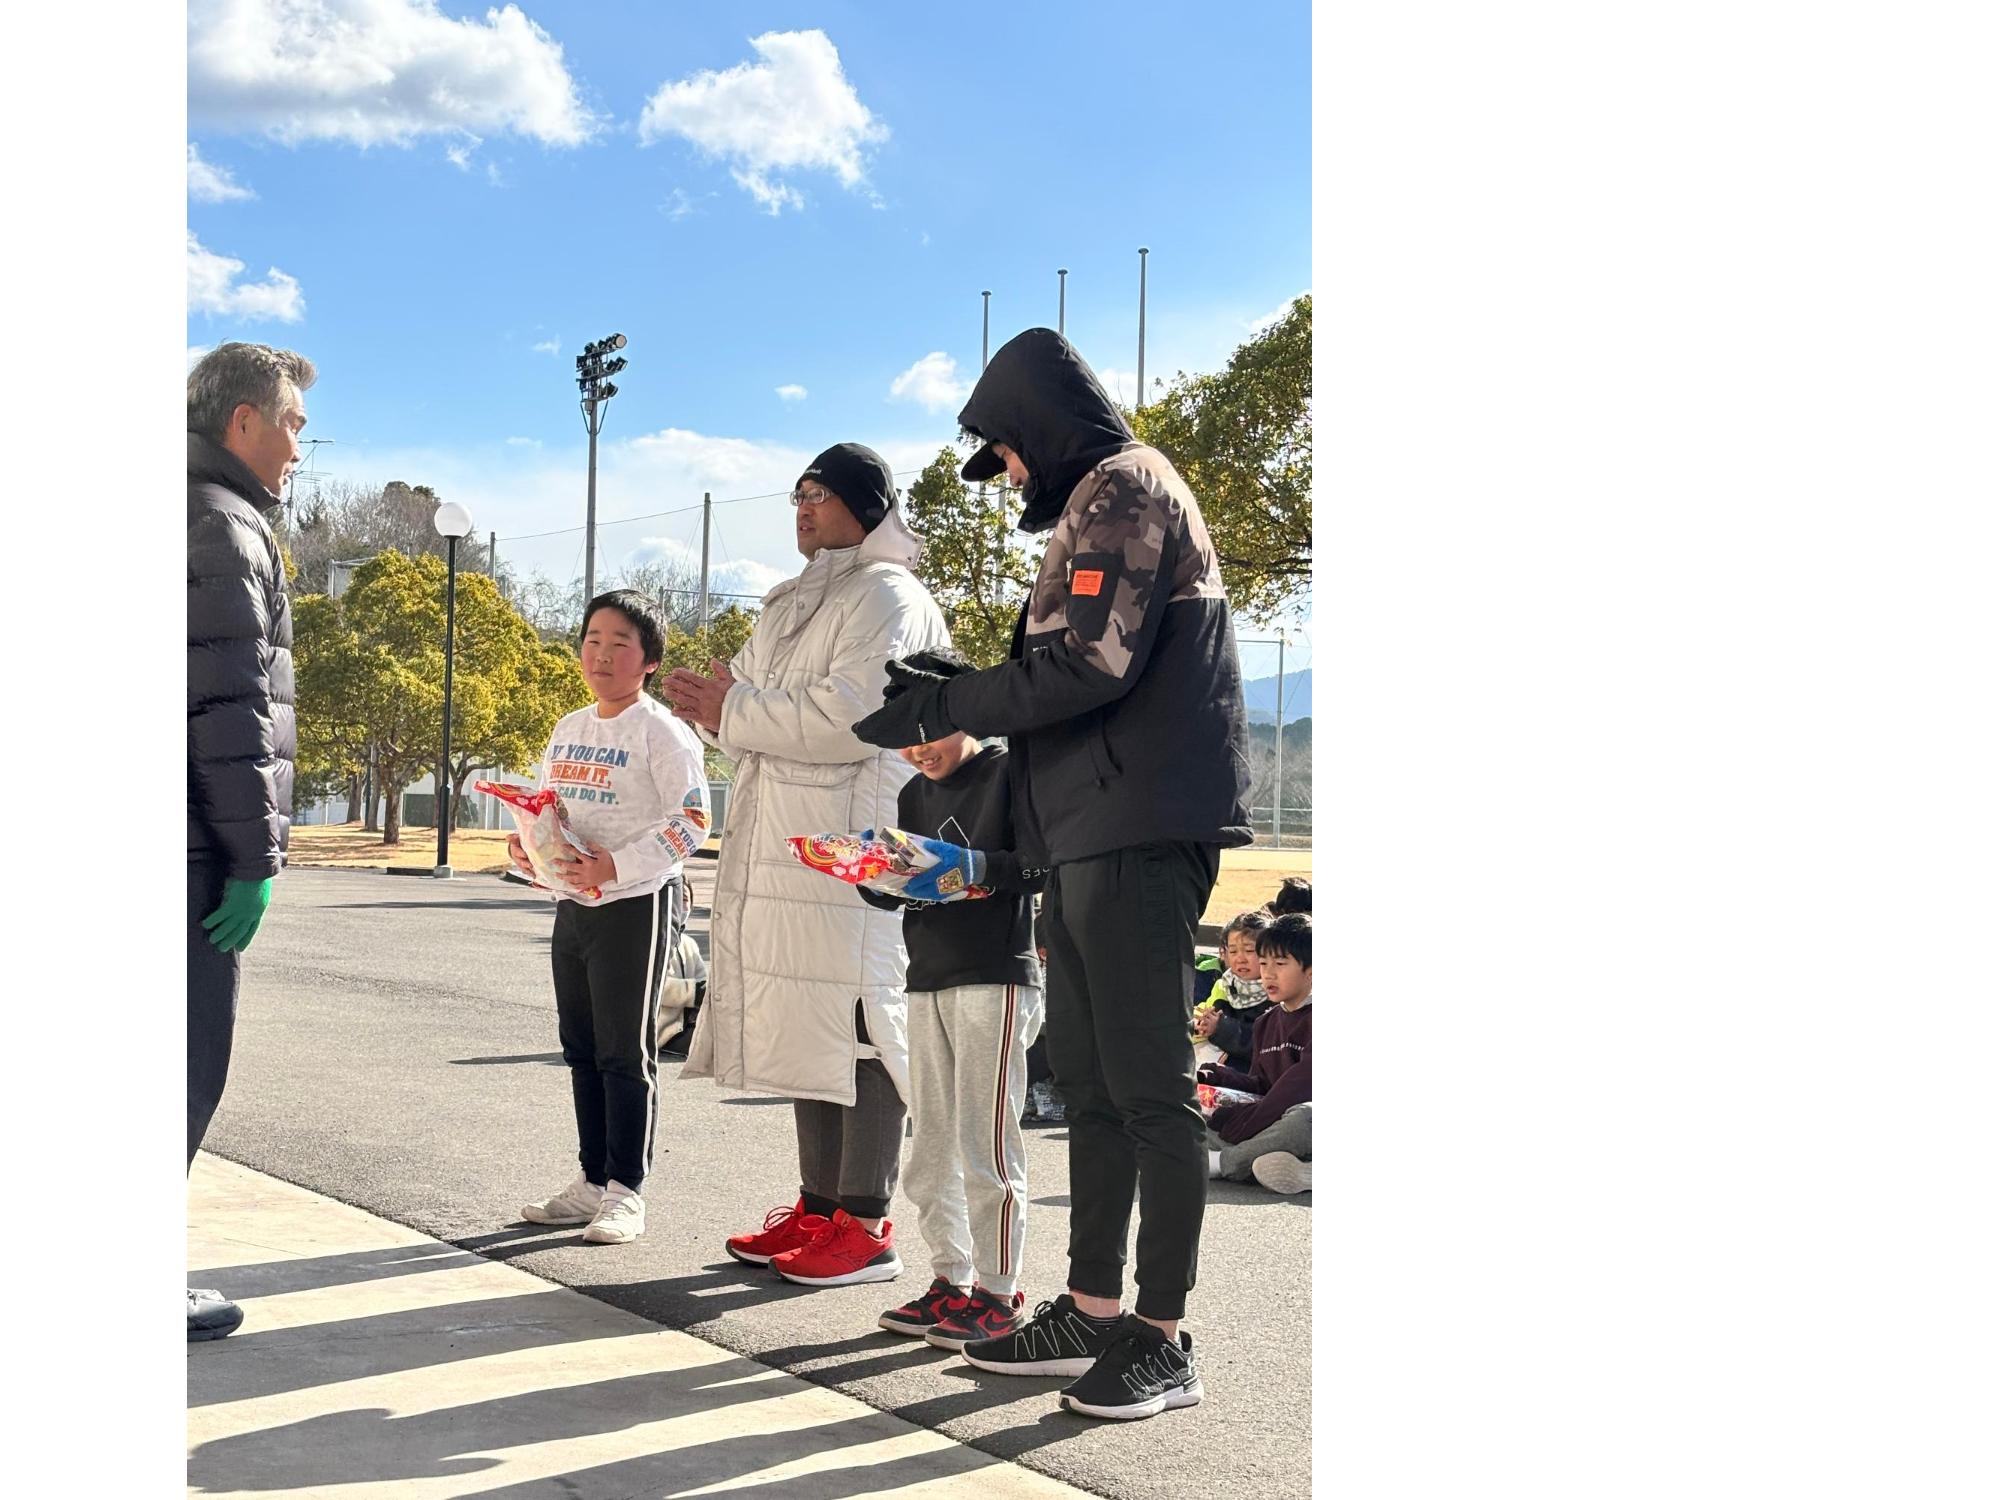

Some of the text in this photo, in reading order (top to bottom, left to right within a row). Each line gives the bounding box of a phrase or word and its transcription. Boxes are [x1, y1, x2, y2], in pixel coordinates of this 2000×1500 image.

[566, 744, 596, 761] YOU
[594, 748, 630, 767] CAN
[579, 788, 596, 801] DO
[600, 791, 620, 805] IT.
[680, 827, 694, 847] YOU
